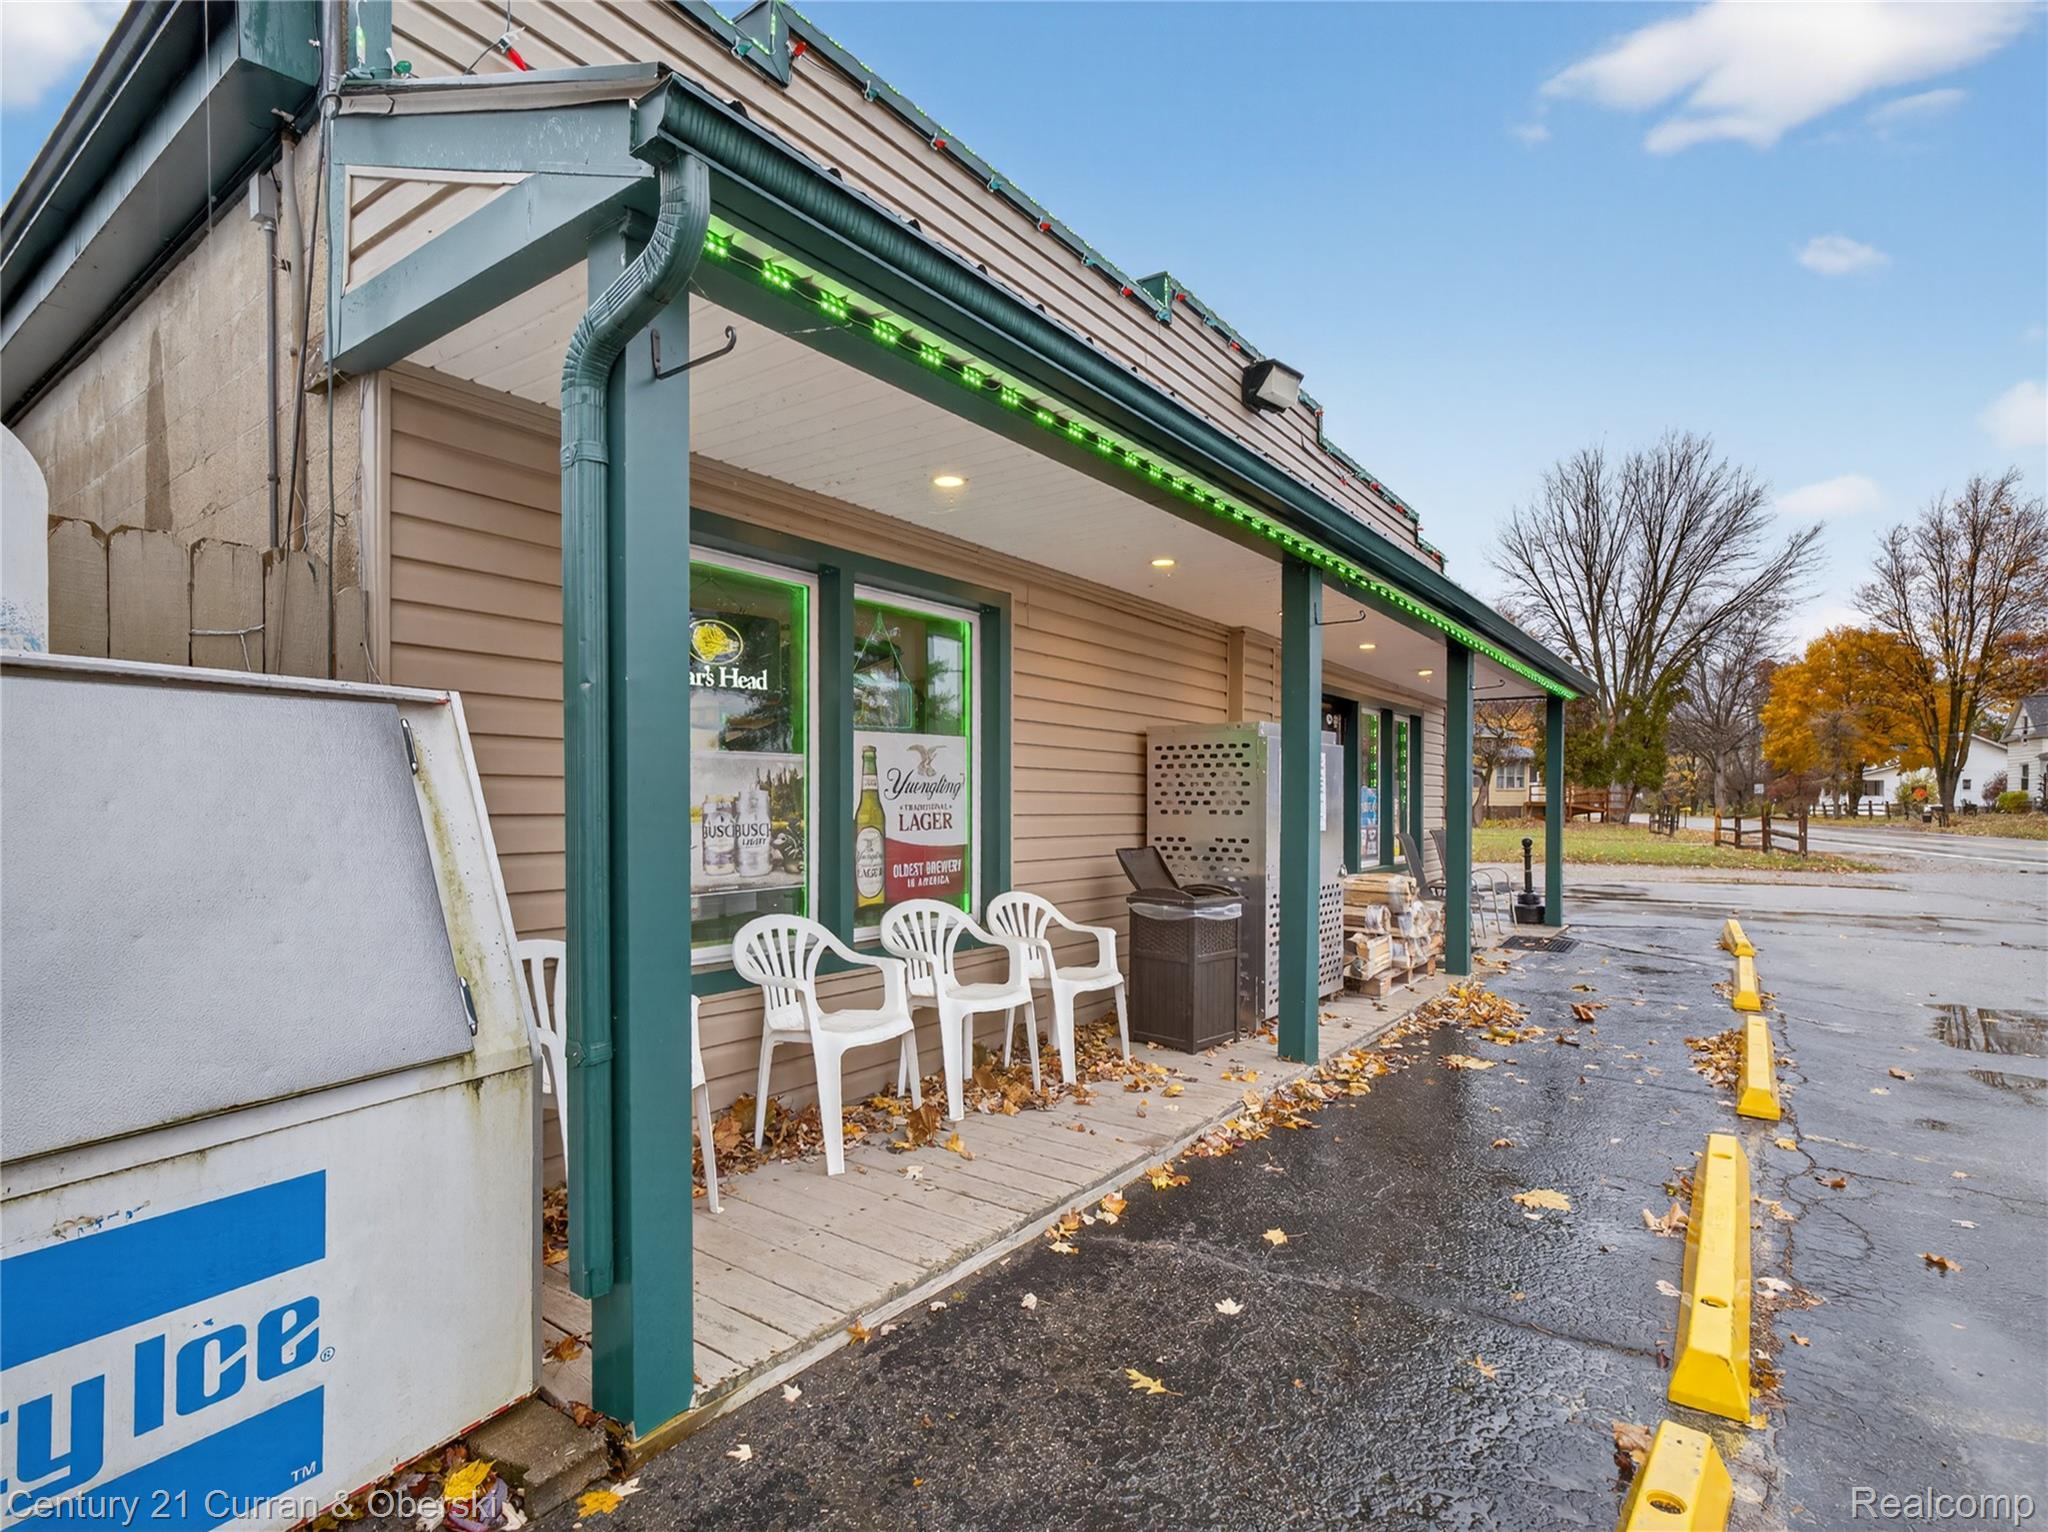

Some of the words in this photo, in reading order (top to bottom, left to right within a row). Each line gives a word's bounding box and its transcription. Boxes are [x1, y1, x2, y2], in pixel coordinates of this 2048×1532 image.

[719, 666, 768, 690] Head
[884, 767, 961, 800] Yuengling
[899, 812, 952, 831] LAGER
[893, 862, 924, 878] OLDEST
[134, 1296, 320, 1438] Ice
